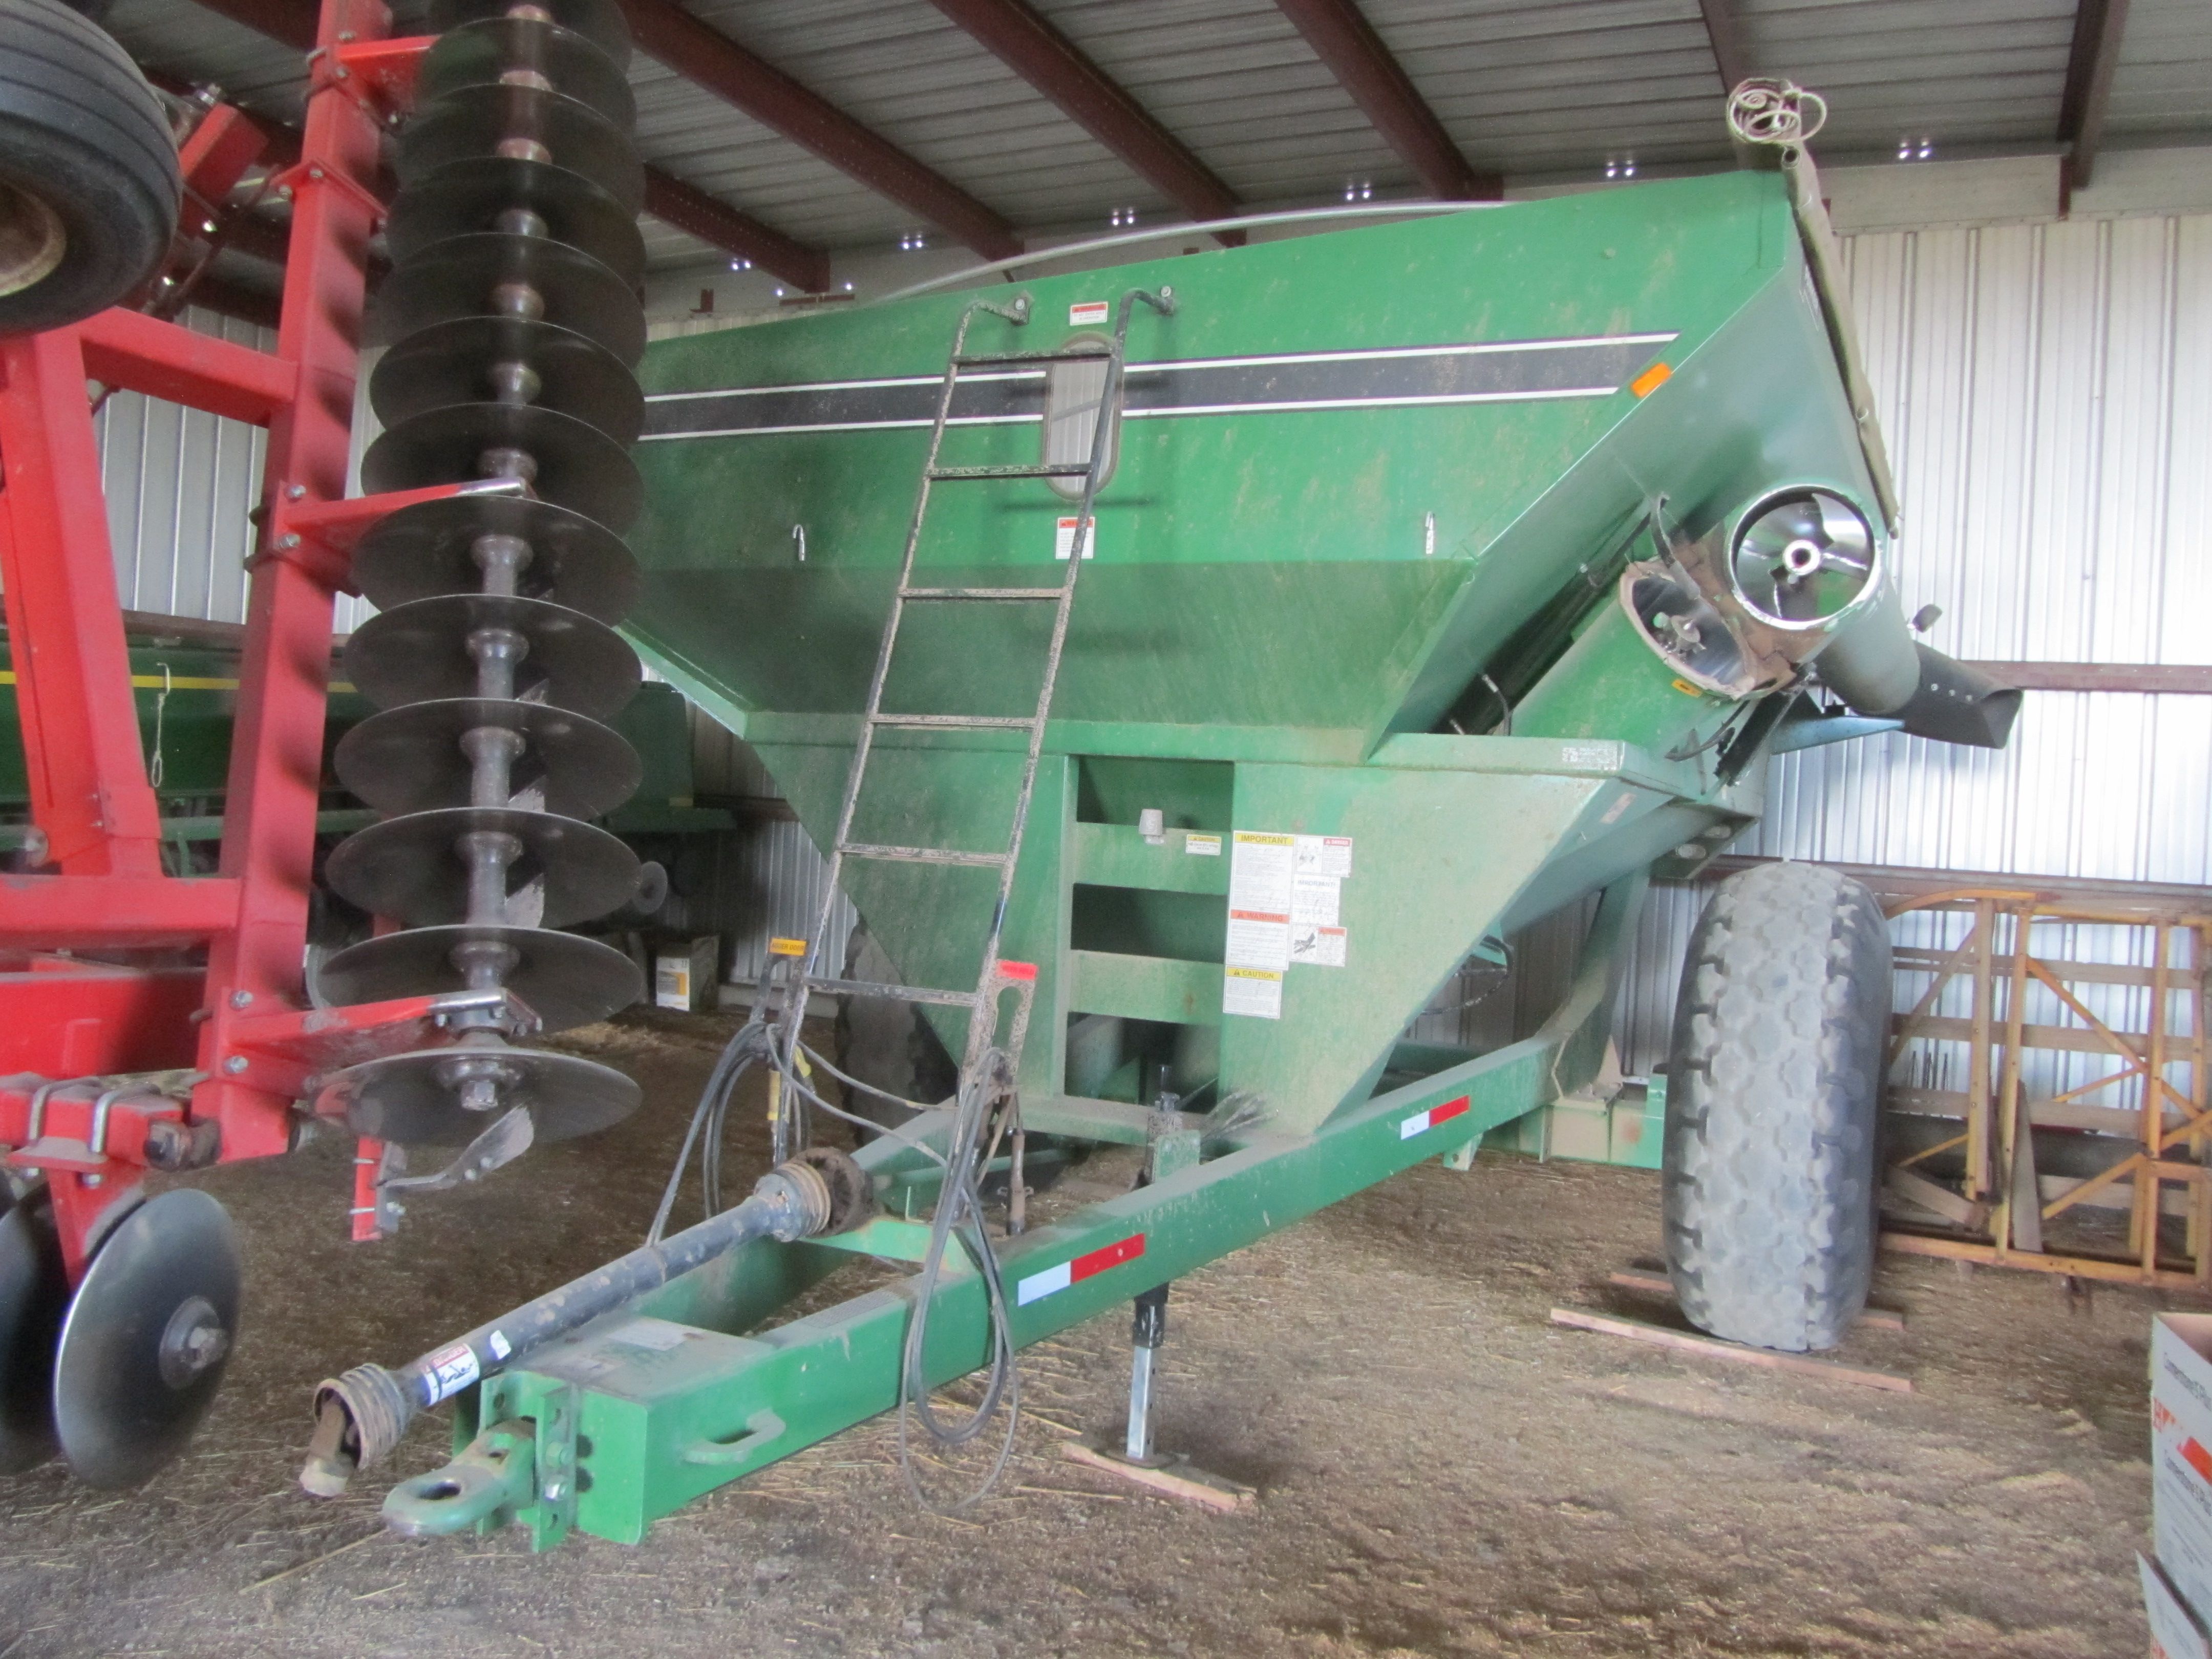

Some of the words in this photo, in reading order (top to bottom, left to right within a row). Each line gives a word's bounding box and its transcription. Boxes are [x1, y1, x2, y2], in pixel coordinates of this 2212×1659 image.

[1241, 834, 1288, 844] IMPORTANT
[1247, 912, 1283, 922] WARNING
[1242, 970, 1274, 979] CAUTION
